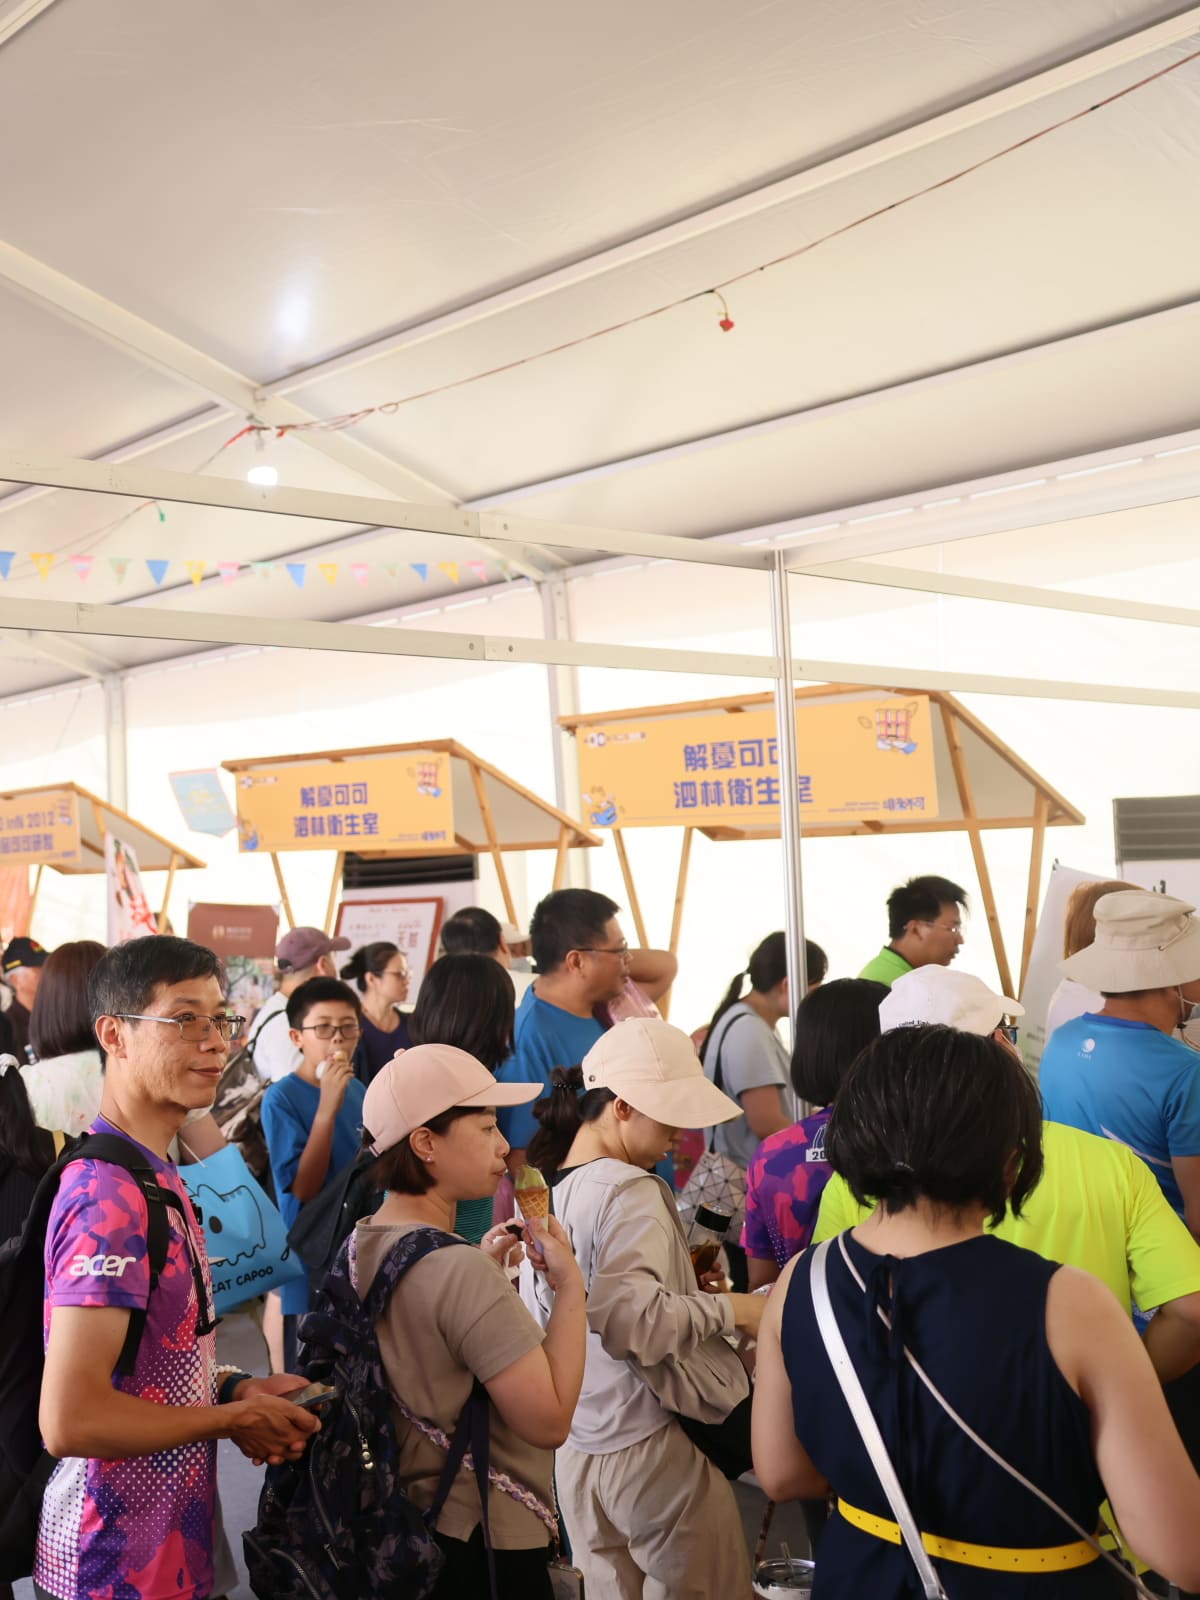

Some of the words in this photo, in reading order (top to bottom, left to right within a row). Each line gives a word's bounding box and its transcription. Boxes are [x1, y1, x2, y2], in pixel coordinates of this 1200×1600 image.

[300, 782, 368, 808] 解憂可可
[69, 1254, 137, 1277] acer
[236, 1266, 274, 1286] CAPOO
